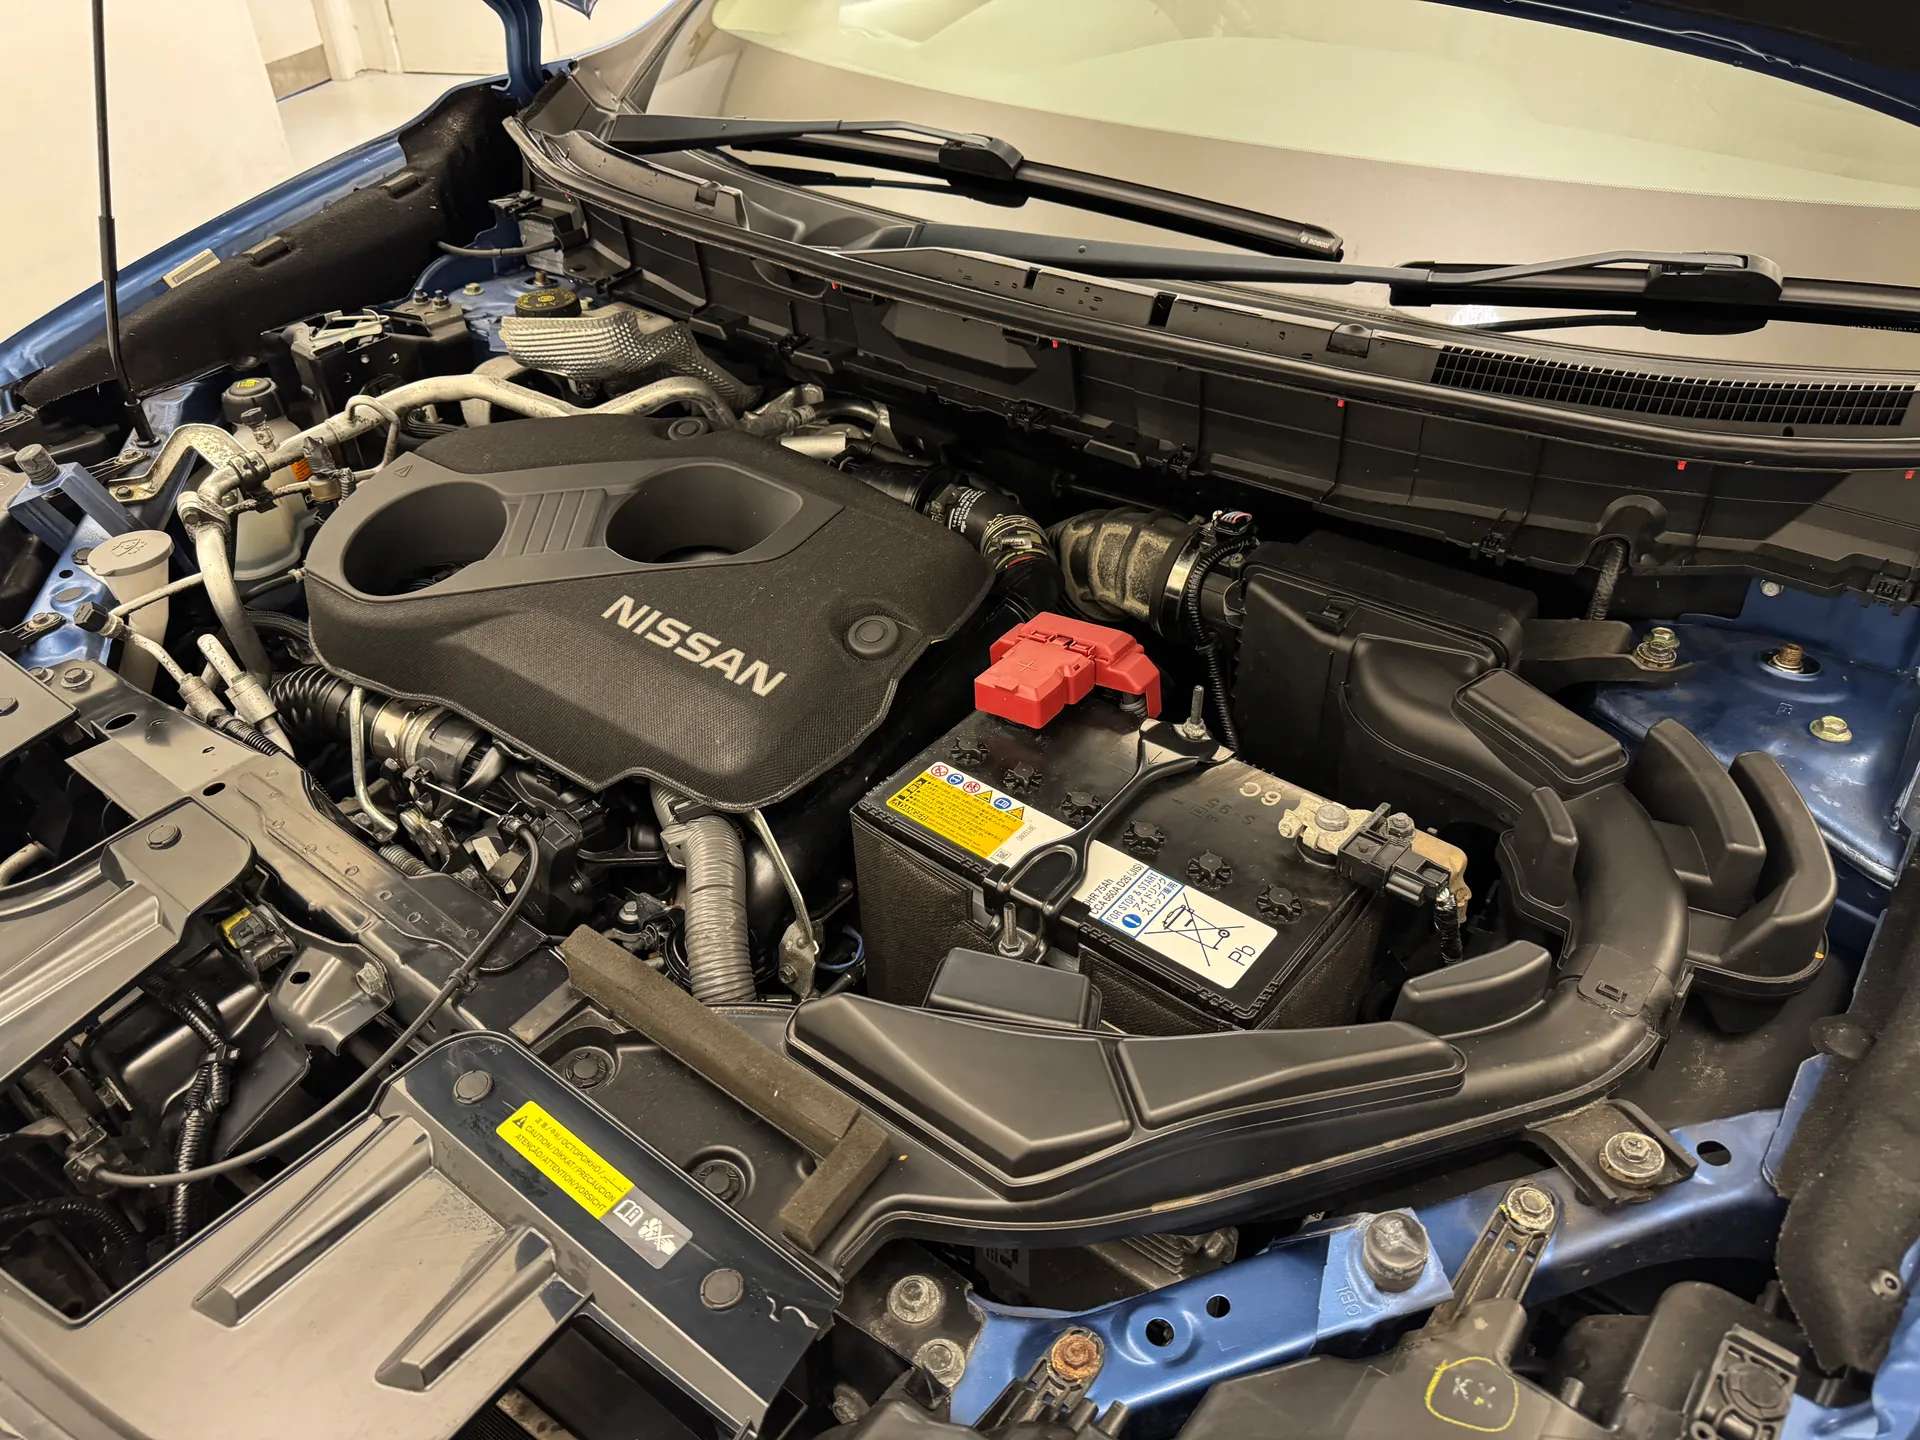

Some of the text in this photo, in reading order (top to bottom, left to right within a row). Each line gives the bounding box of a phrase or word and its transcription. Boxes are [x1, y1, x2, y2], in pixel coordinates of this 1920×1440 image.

[600, 594, 788, 697] NISSAN
[1106, 909, 1122, 923] FOR
[1119, 894, 1136, 911] STOP
[1138, 872, 1158, 891] START
[1228, 945, 1256, 966] Pb
